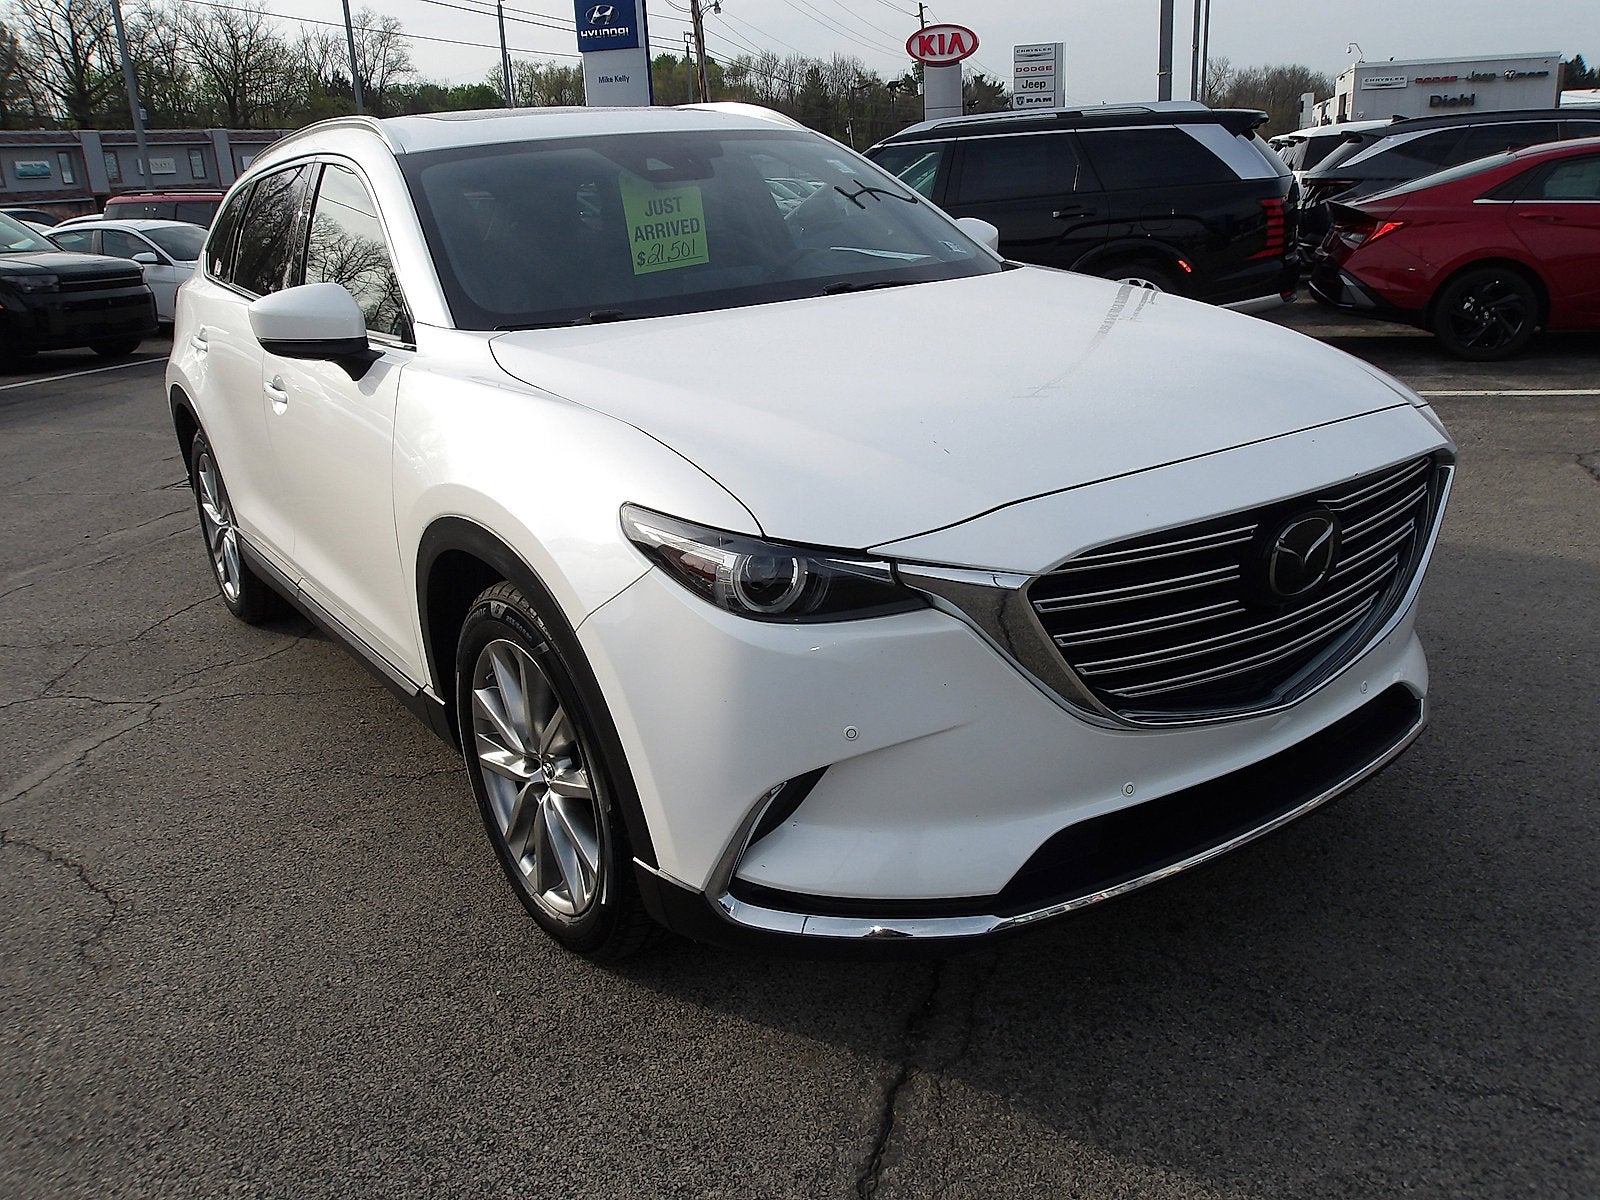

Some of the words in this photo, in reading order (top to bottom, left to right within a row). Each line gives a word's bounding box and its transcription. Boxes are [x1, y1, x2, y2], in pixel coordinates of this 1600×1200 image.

[580, 26, 629, 38] HYUNDAI
[918, 32, 966, 57] KIA
[1015, 65, 1053, 73] DODGE
[598, 76, 613, 84] Mike
[614, 75, 631, 84] Kelly
[1021, 79, 1047, 90] Jeep
[1429, 92, 1476, 108] Diehl
[644, 195, 683, 217] JUST
[634, 217, 700, 242] ARRIVED
